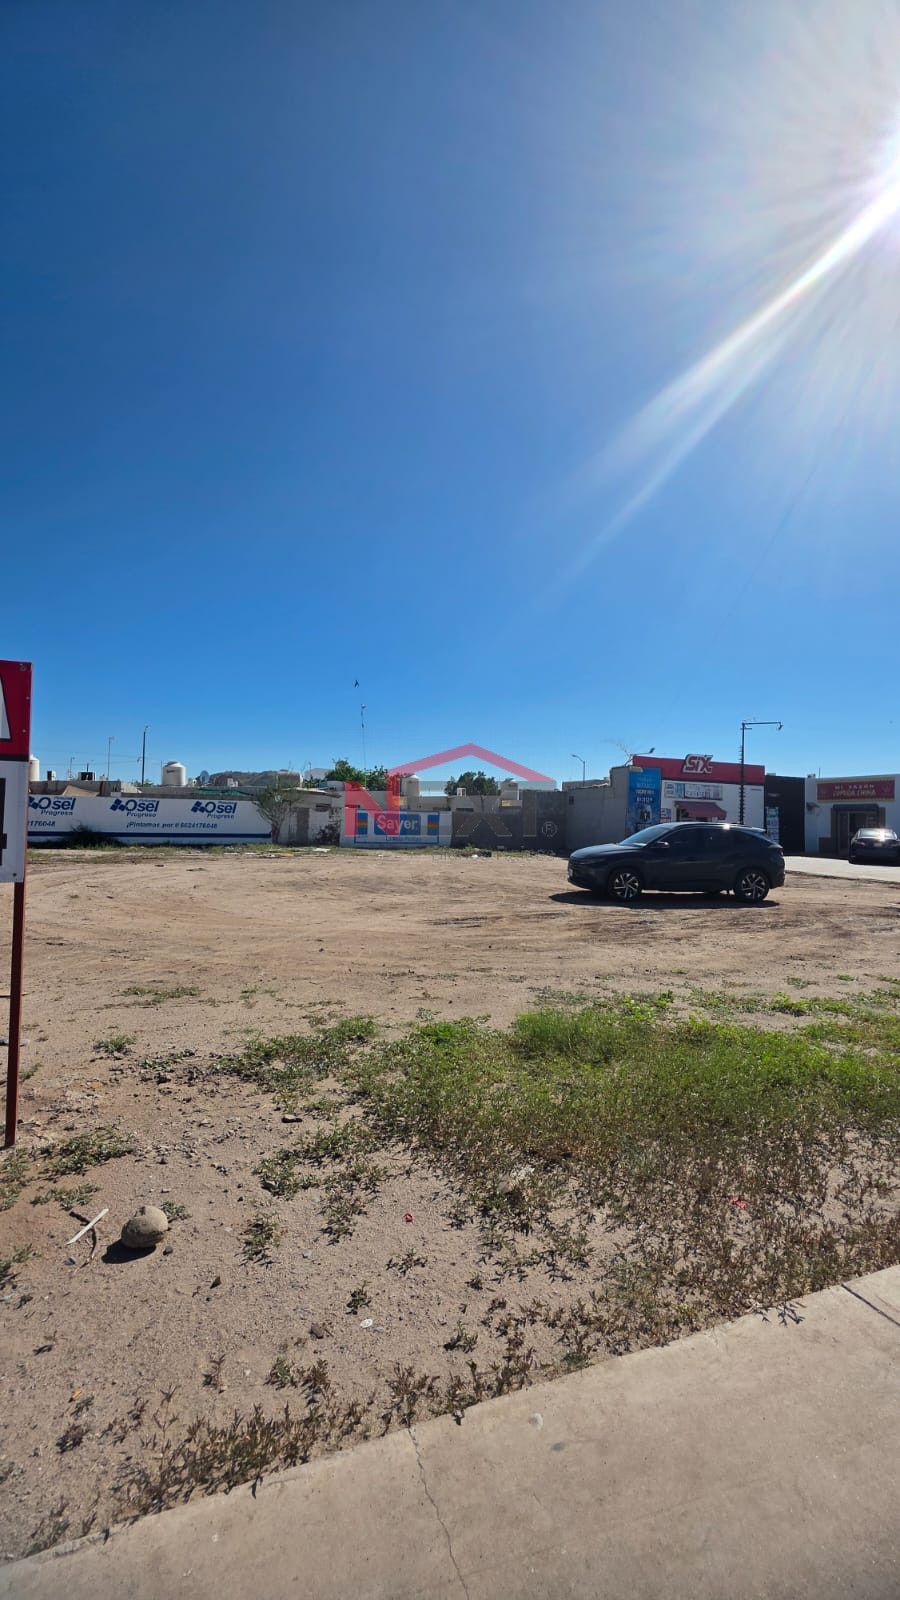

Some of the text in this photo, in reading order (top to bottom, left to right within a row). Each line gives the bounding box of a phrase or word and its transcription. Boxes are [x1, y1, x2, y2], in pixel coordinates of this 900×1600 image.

[39, 796, 76, 810] Osel
[126, 799, 160, 812] Osel
[205, 801, 237, 814] Osel
